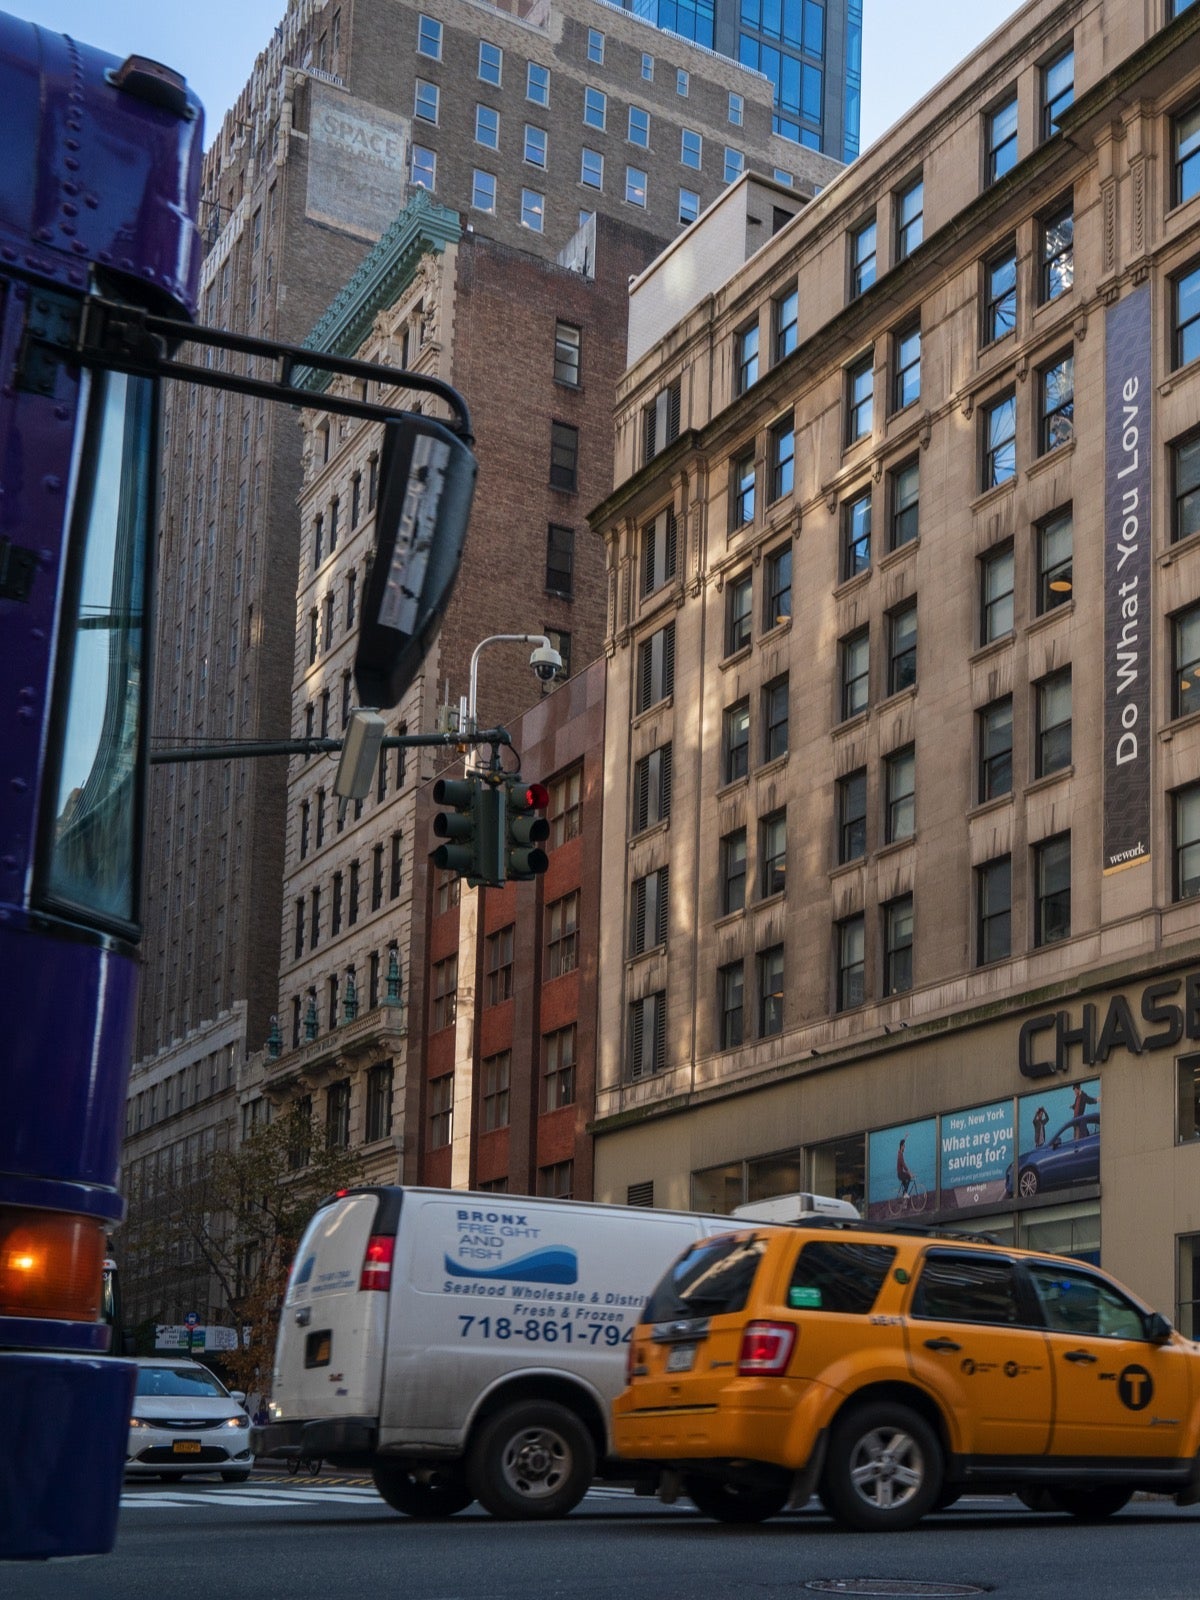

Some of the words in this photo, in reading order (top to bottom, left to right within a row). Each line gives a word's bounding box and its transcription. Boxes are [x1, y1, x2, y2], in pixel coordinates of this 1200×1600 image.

[323, 114, 397, 160] SPACE
[1117, 375, 1139, 479] Love
[1117, 487, 1139, 572] You
[1116, 575, 1138, 695] What
[1116, 703, 1138, 766] Do
[1110, 841, 1145, 864] wework
[950, 1117, 967, 1131] Hey,
[968, 1113, 985, 1125] New
[987, 1108, 1005, 1121] York
[942, 1134, 971, 1153] What
[973, 1131, 990, 1147] are
[992, 1127, 1013, 1146] you
[948, 1152, 983, 1170] saving
[985, 1145, 1007, 1163] for?
[457, 1210, 528, 1226] BRONX
[459, 1234, 504, 1248] AND
[459, 1247, 502, 1260] FISH
[443, 1281, 505, 1296] Seafood
[512, 1286, 586, 1302] Wholesale
[590, 1292, 599, 1303] &
[605, 1293, 650, 1307] Distri
[513, 1304, 556, 1318] Fresh
[561, 1308, 570, 1318] &
[575, 1309, 625, 1322] Frozen
[1125, 1373, 1147, 1405] T
